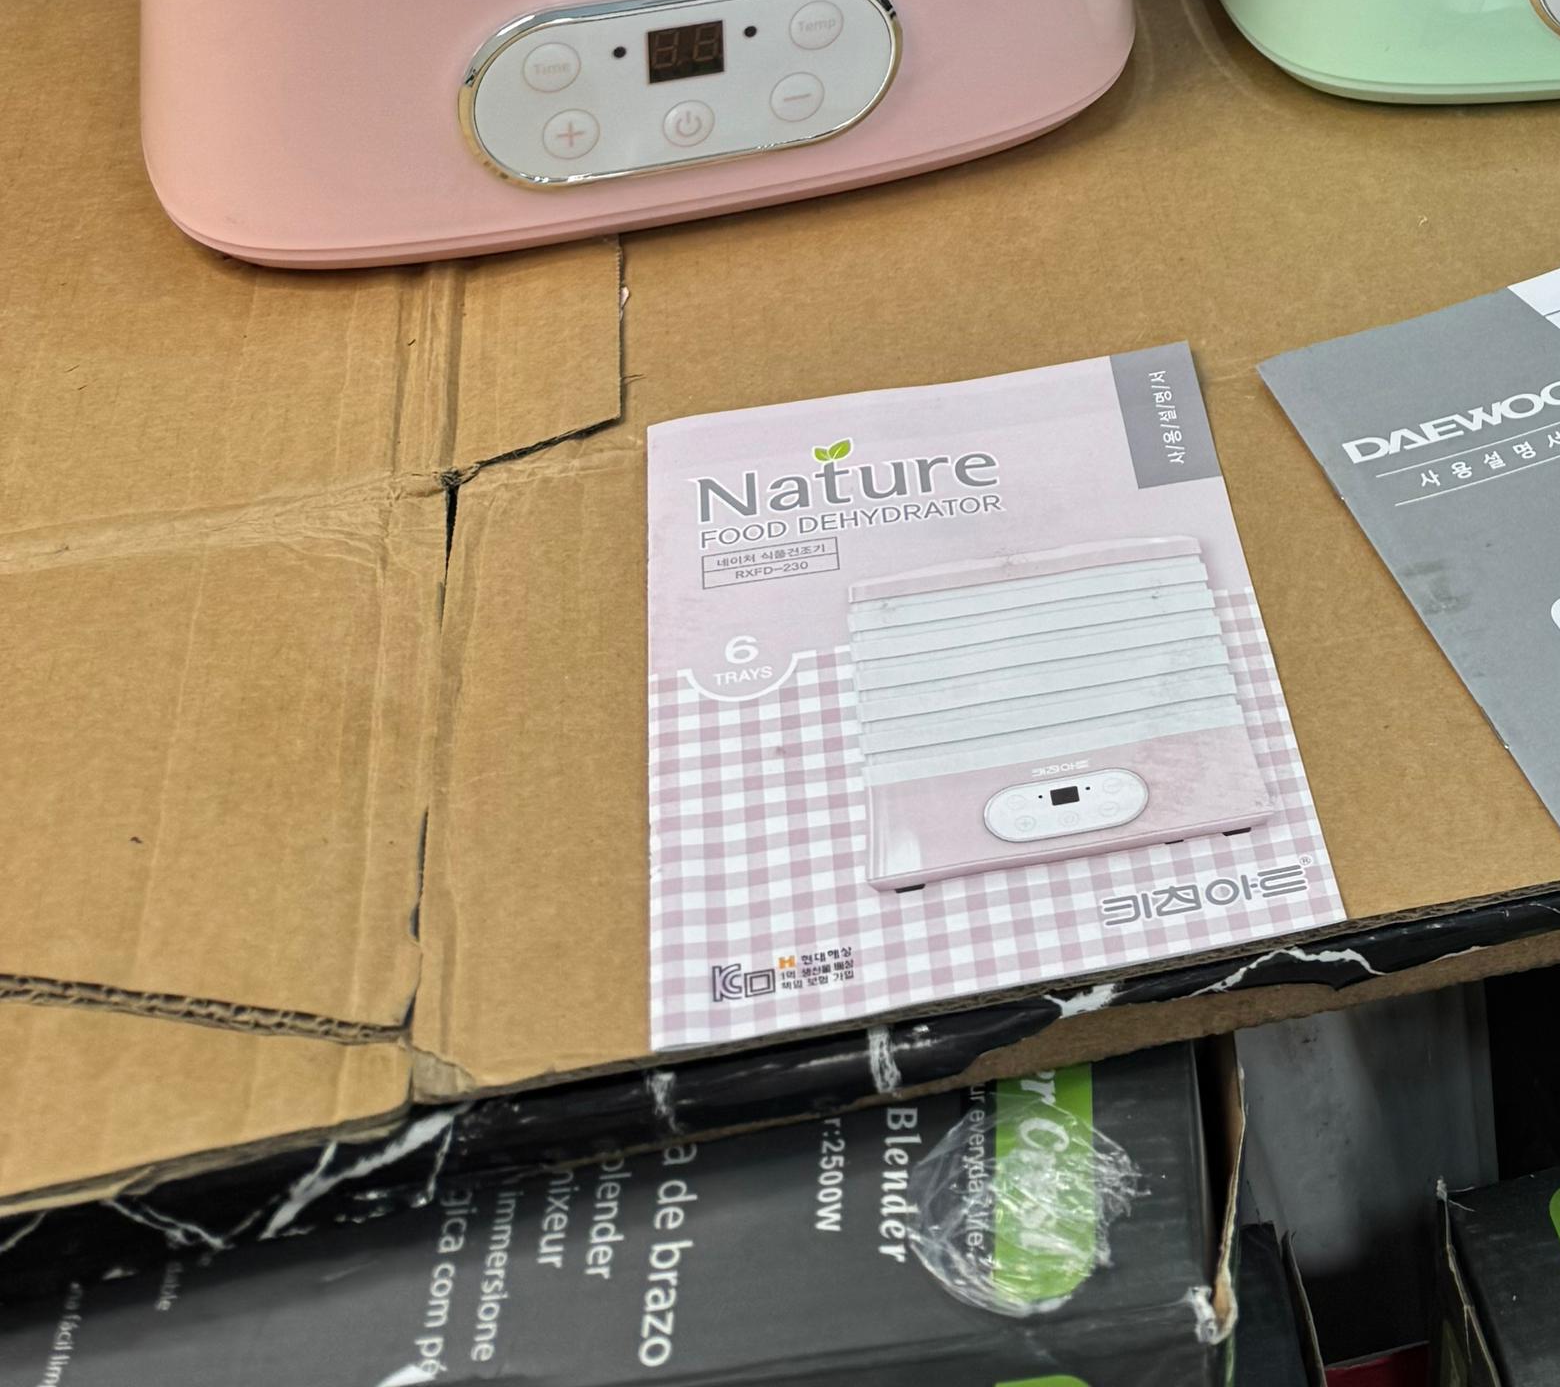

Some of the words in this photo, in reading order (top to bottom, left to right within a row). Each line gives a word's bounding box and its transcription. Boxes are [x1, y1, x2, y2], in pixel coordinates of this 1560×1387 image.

[797, 17, 838, 34] Temp
[532, 61, 571, 77] Time
[1148, 369, 1185, 467] 사/용/설/명/서
[696, 448, 1001, 524] Nature
[700, 518, 788, 550] FOOD
[797, 493, 1003, 538] DEHYDRATOR
[716, 553, 759, 570] 네이처
[760, 541, 827, 563] 식품건조기
[734, 559, 810, 581] RXFD-230
[723, 634, 759, 665] 6
[712, 665, 774, 687] TRAYS
[877, 1106, 921, 1264] Blender
[636, 1243, 693, 1369] brazo
